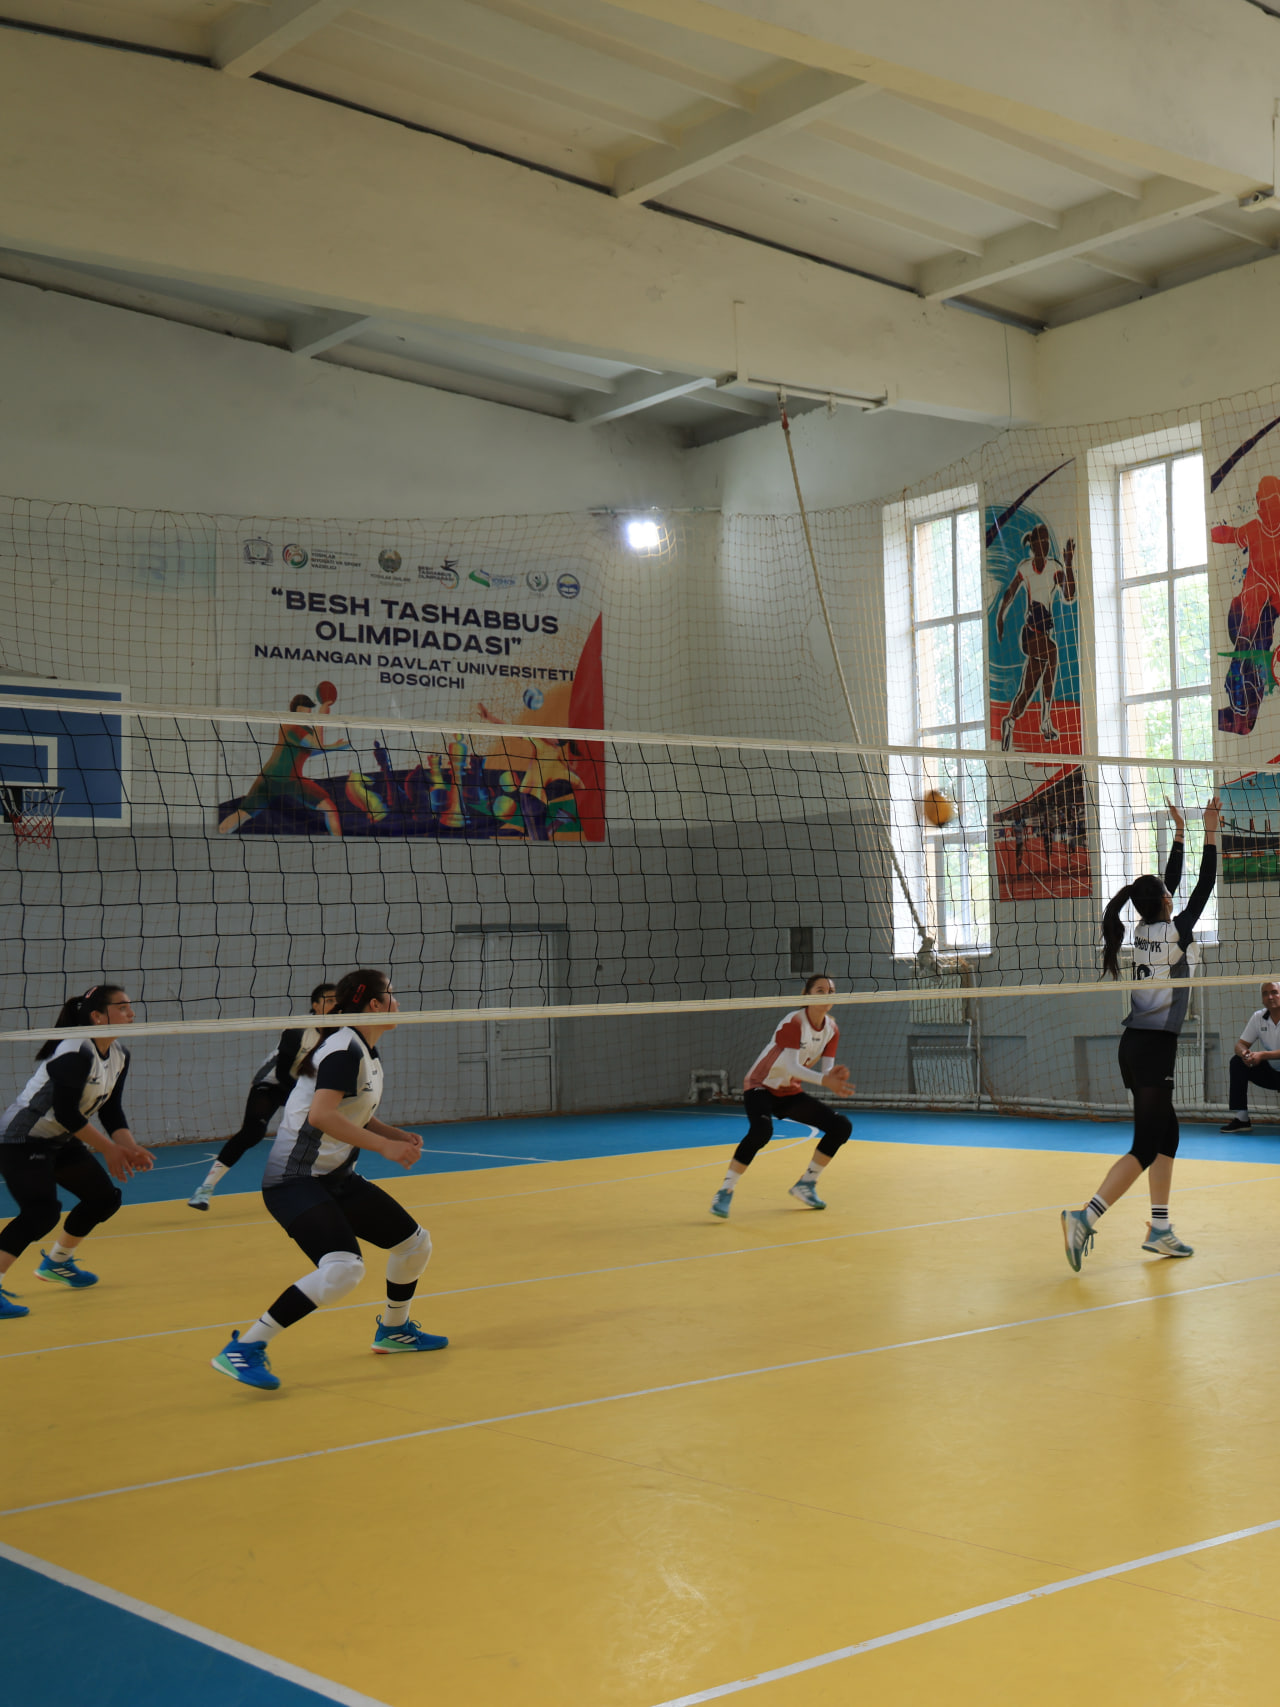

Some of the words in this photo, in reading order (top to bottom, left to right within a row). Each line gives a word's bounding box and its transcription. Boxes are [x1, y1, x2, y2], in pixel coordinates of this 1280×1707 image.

[381, 599, 559, 634] TASHABBUS
[254, 644, 371, 667] NAMANGAN
[378, 655, 451, 673] DAVLAT
[457, 661, 574, 682] UNIVERSITETI
[380, 671, 465, 689] BOSQICHI
